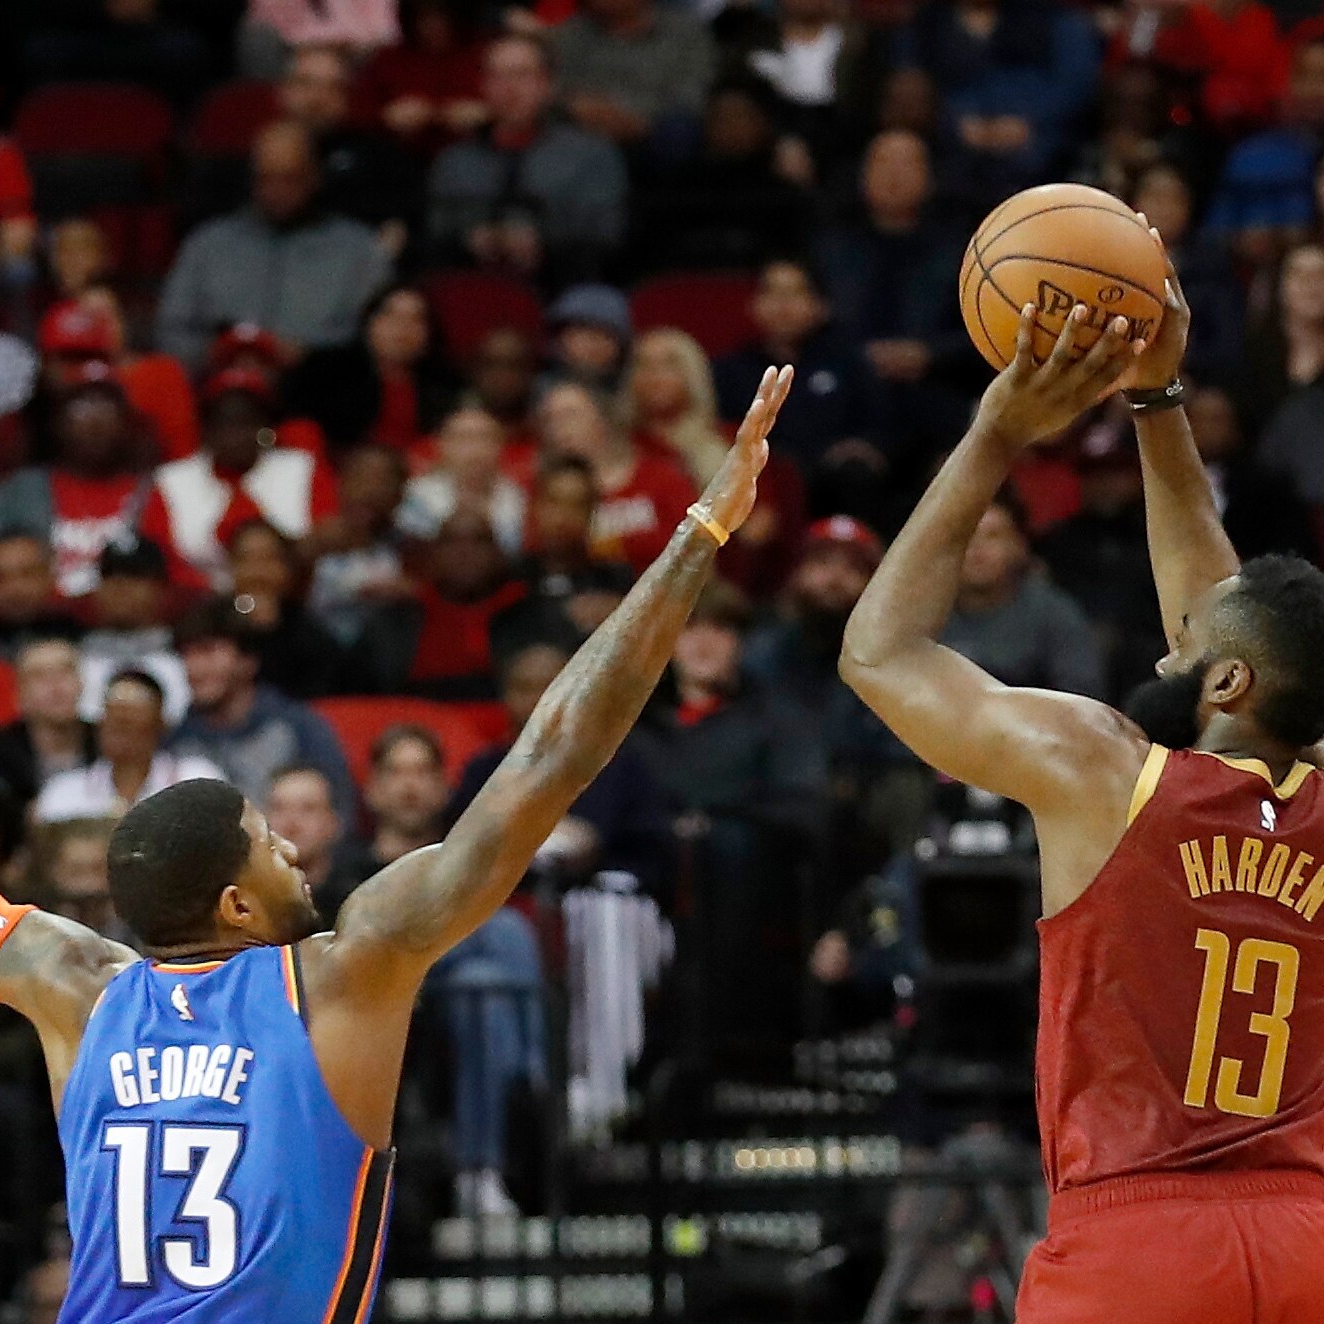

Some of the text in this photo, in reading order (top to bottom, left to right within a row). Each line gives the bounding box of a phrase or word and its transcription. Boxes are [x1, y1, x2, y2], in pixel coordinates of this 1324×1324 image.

[109, 1044, 254, 1108] GEORGE
[1183, 927, 1300, 1118] 13
[100, 1119, 247, 1293] 13
